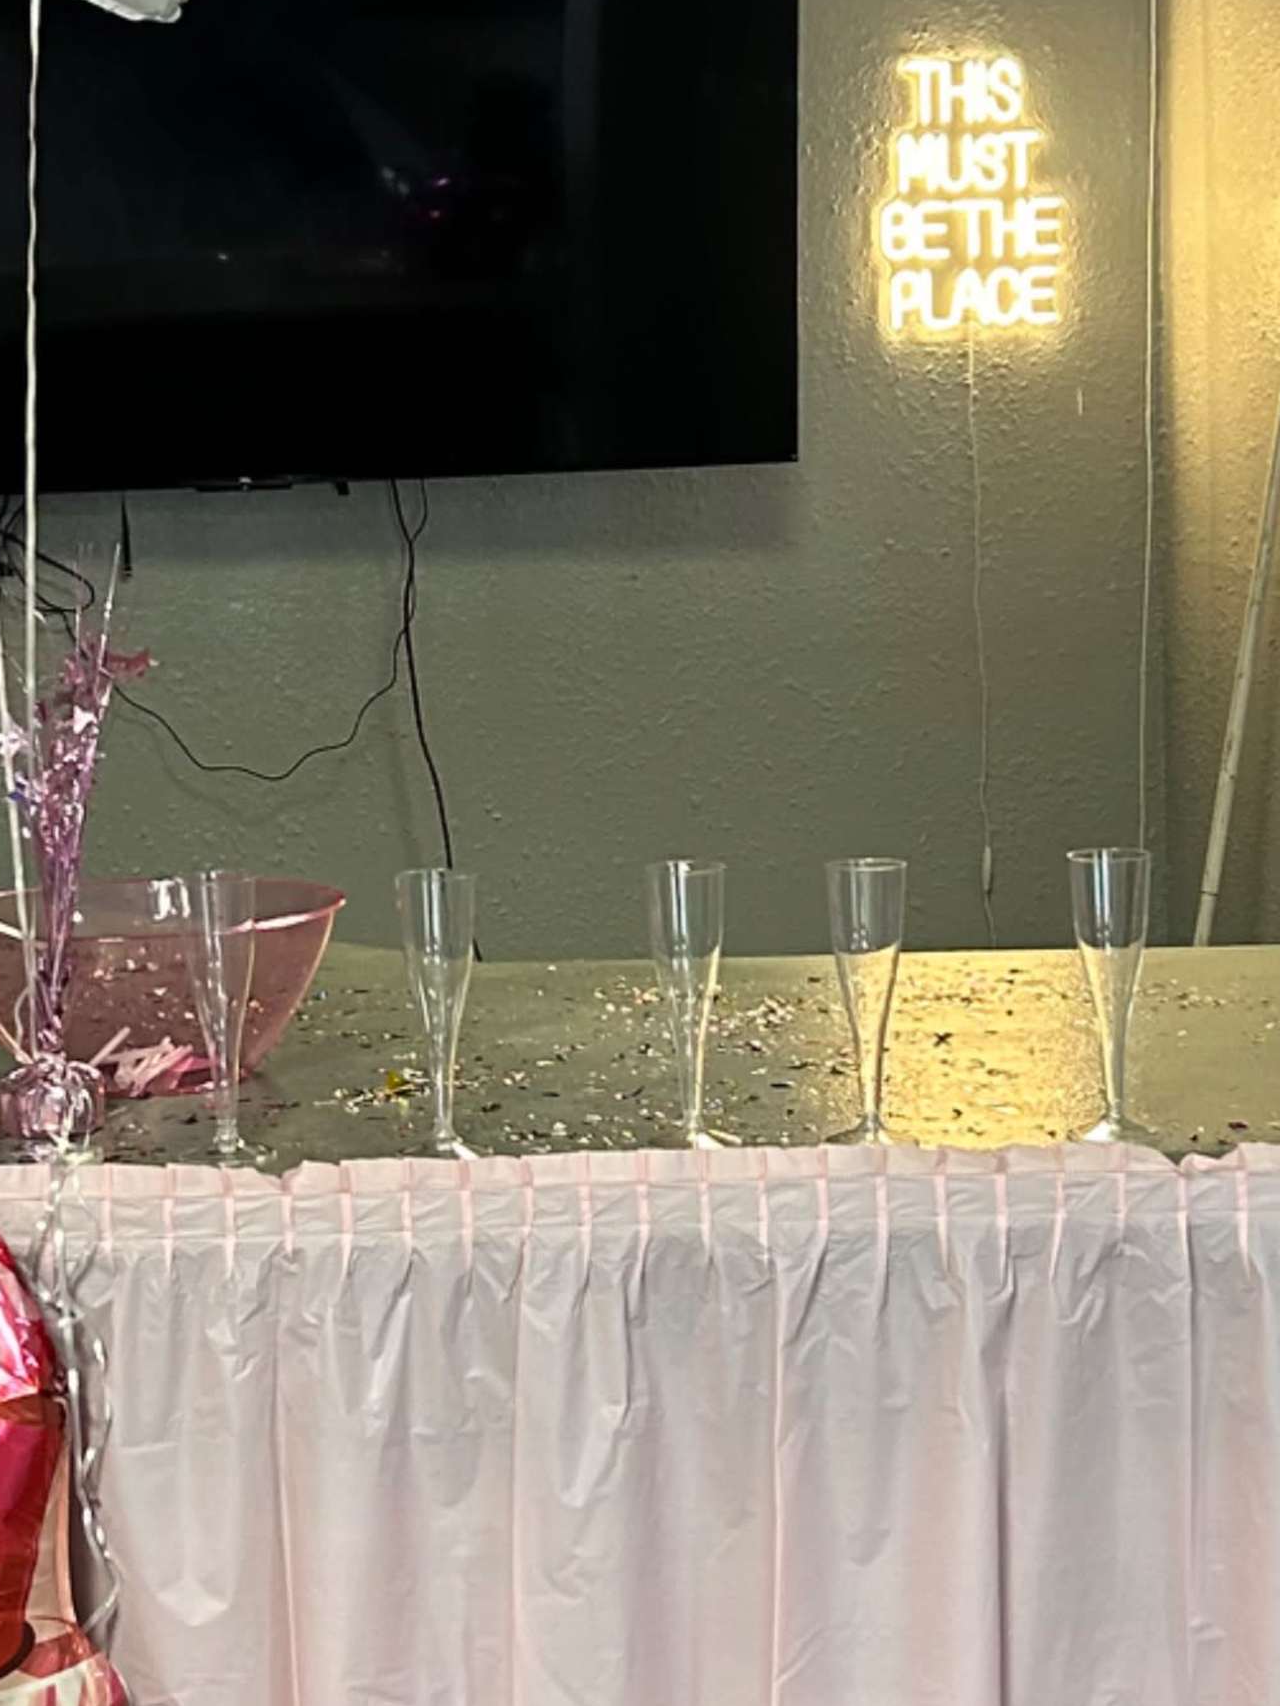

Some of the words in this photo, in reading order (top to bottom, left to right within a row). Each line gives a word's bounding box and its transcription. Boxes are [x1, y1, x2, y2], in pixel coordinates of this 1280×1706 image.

[897, 56, 1023, 126] THIS
[894, 129, 1043, 193] MUST
[880, 198, 951, 261] BE
[947, 196, 1063, 259] THE
[889, 265, 1061, 330] PLACE
